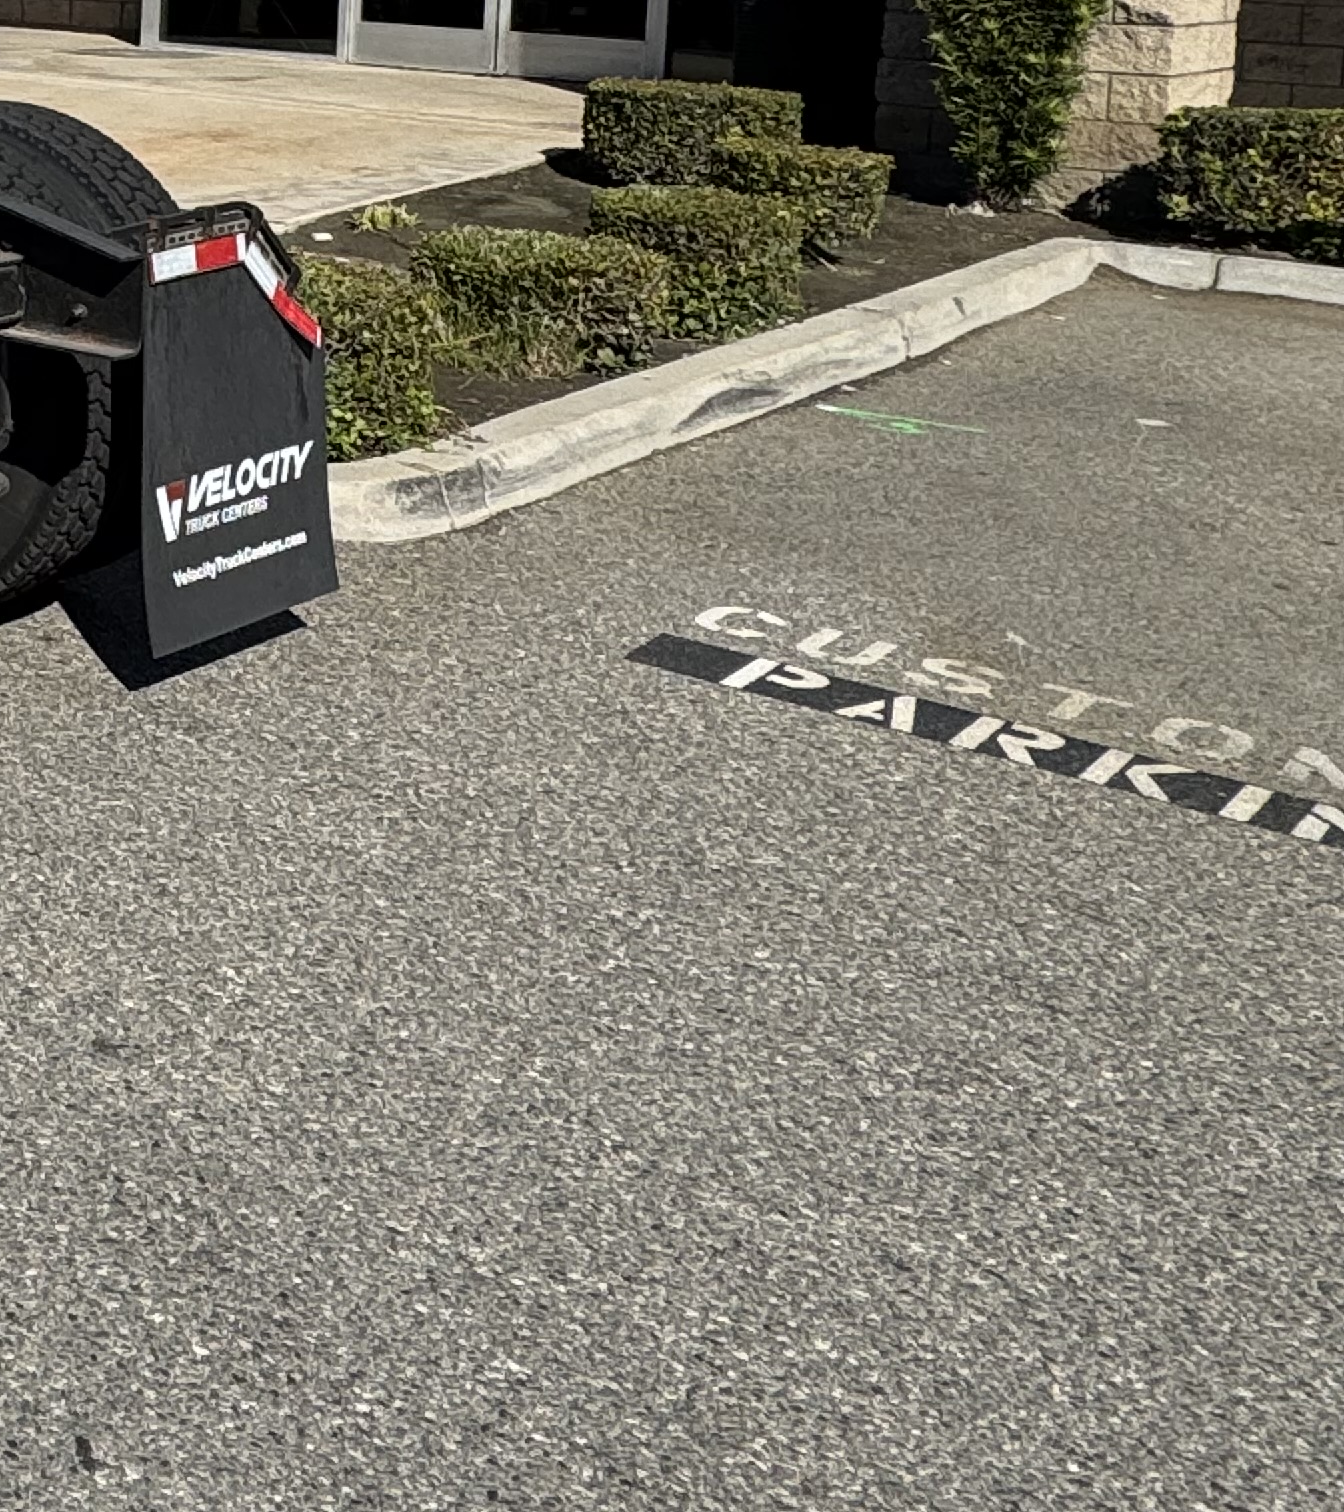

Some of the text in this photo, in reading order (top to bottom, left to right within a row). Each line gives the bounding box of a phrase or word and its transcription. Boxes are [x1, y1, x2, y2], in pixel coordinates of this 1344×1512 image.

[187, 439, 315, 513] VELOCITY
[185, 495, 269, 535] TRUCK CENTERS
[173, 531, 308, 587] VelocityTruckCenters.com
